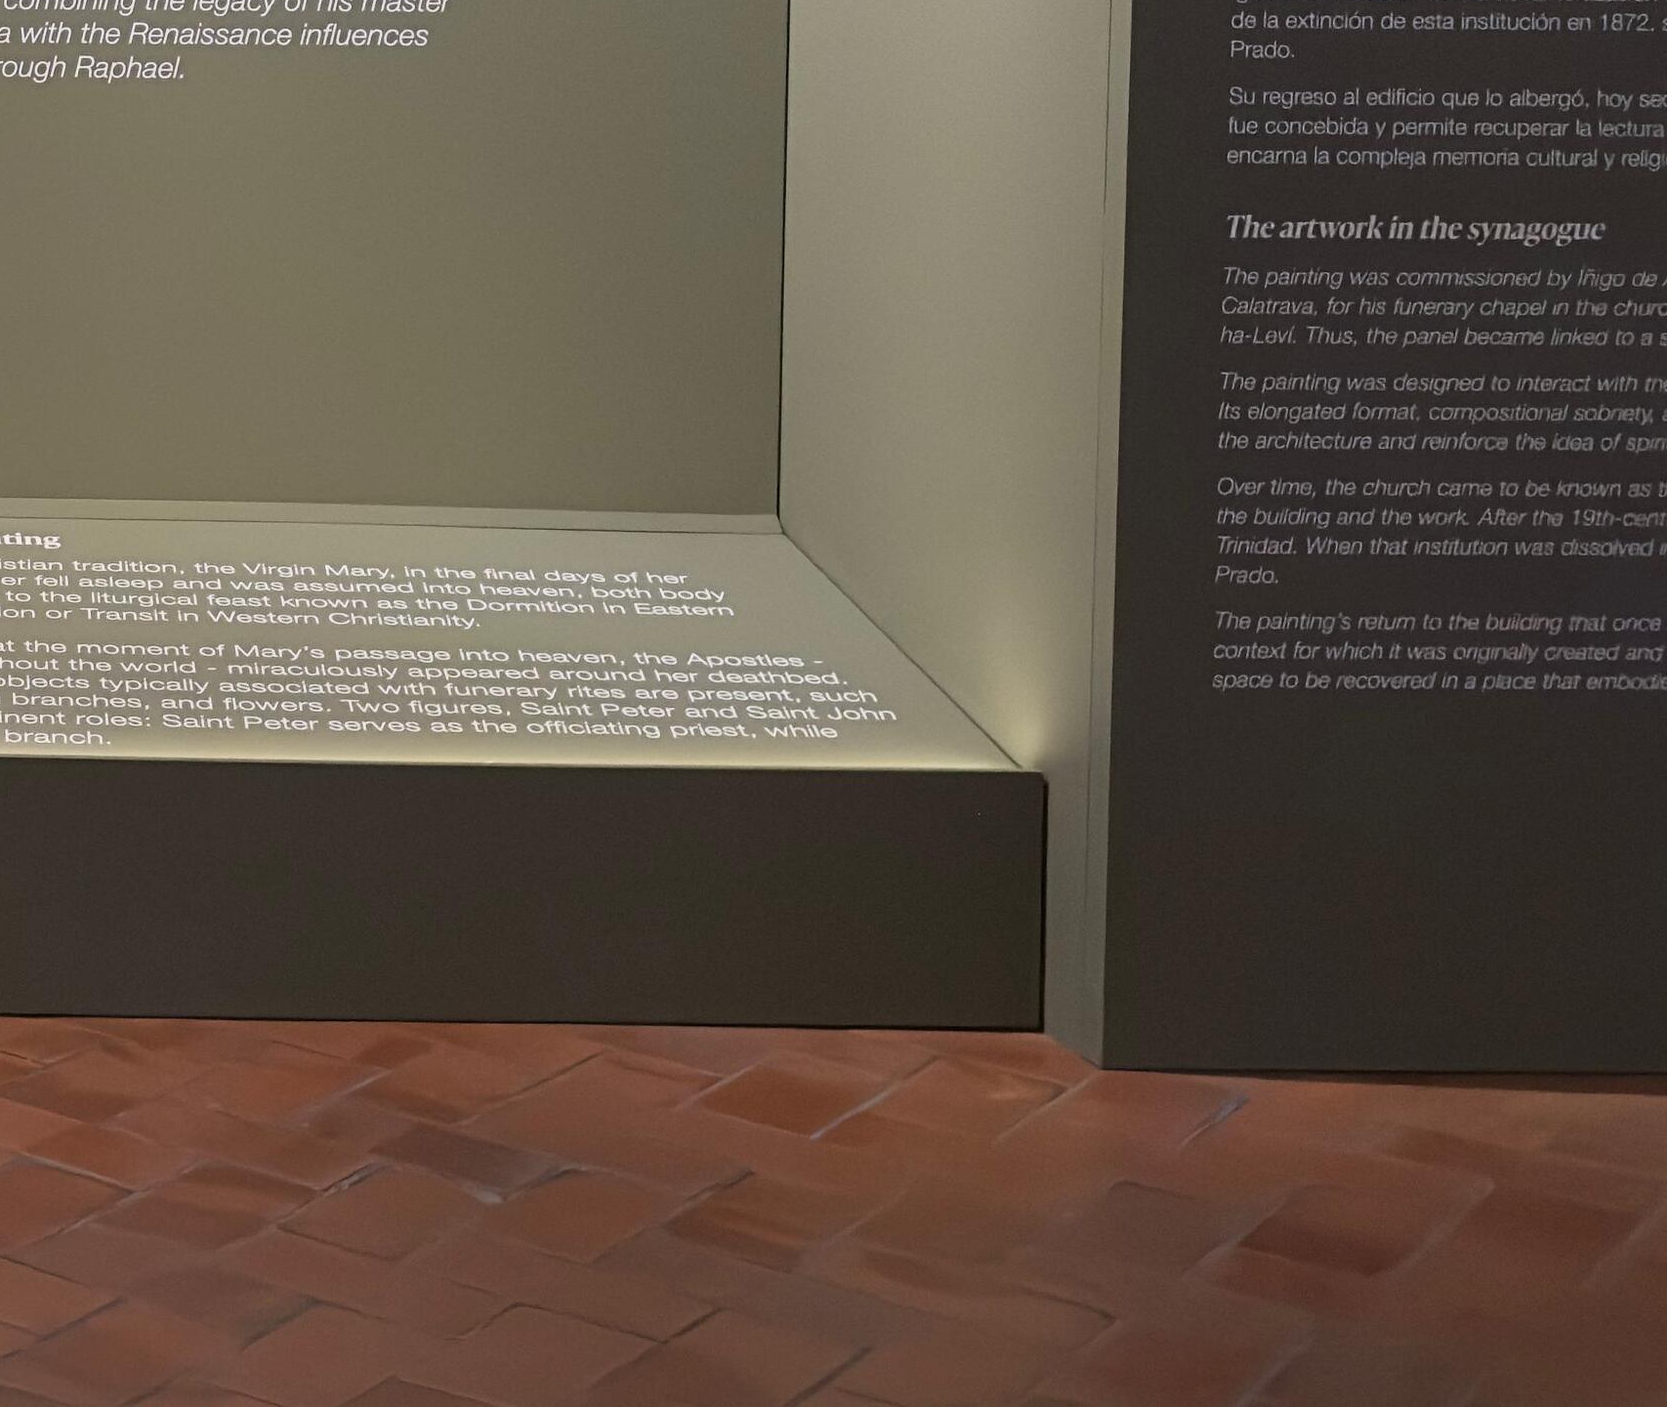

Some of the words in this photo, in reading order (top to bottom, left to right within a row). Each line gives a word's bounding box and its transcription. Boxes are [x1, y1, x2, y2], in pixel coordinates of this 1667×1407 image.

[1230, 39, 1295, 59] Prado.
[74, 54, 184, 84] Raphael.
[1226, 213, 1276, 239] The
[1278, 214, 1384, 240] artwork
[1388, 215, 1415, 240] in
[1419, 214, 1464, 240] the
[1466, 221, 1607, 248] synagogue
[1214, 564, 1279, 586] Prado.
[45, 609, 73, 620] or
[79, 607, 169, 622] Transit
[176, 609, 199, 623] in
[206, 609, 320, 625] Western
[328, 612, 481, 630] Christianity.
[4, 728, 112, 745] branch.
